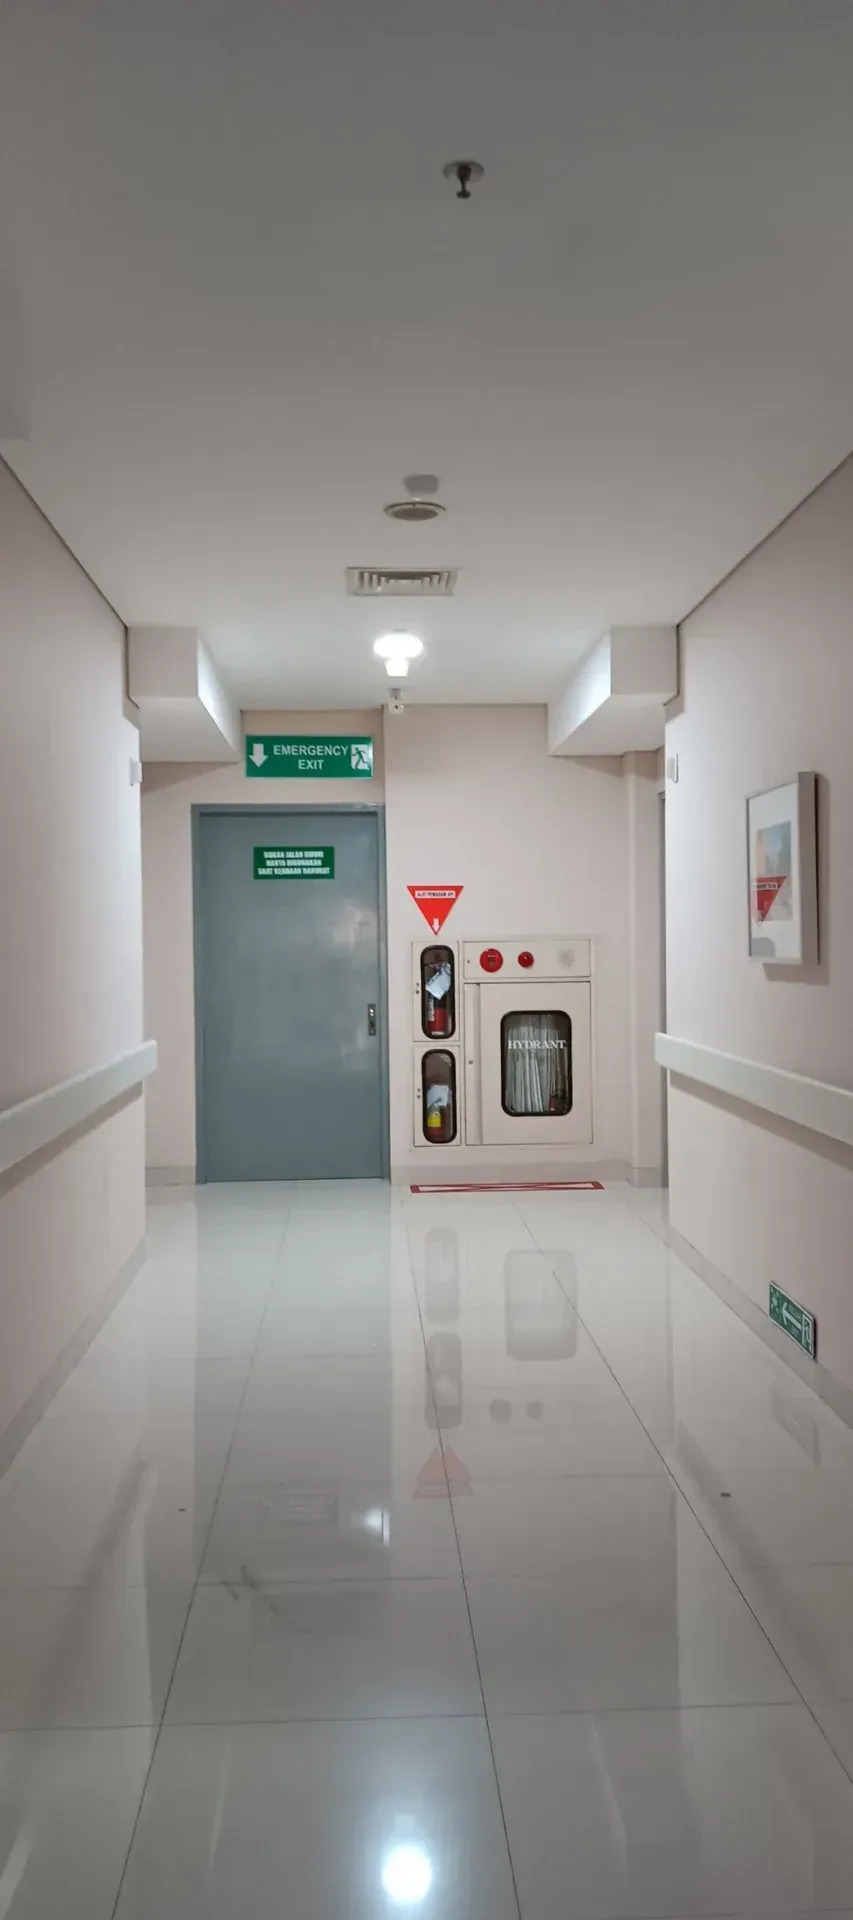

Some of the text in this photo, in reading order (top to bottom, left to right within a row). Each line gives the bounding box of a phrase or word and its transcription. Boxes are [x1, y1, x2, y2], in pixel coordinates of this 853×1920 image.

[273, 744, 349, 756] EMERGENCY
[298, 759, 325, 770] EXIT
[508, 1040, 566, 1050] HYDRANT
